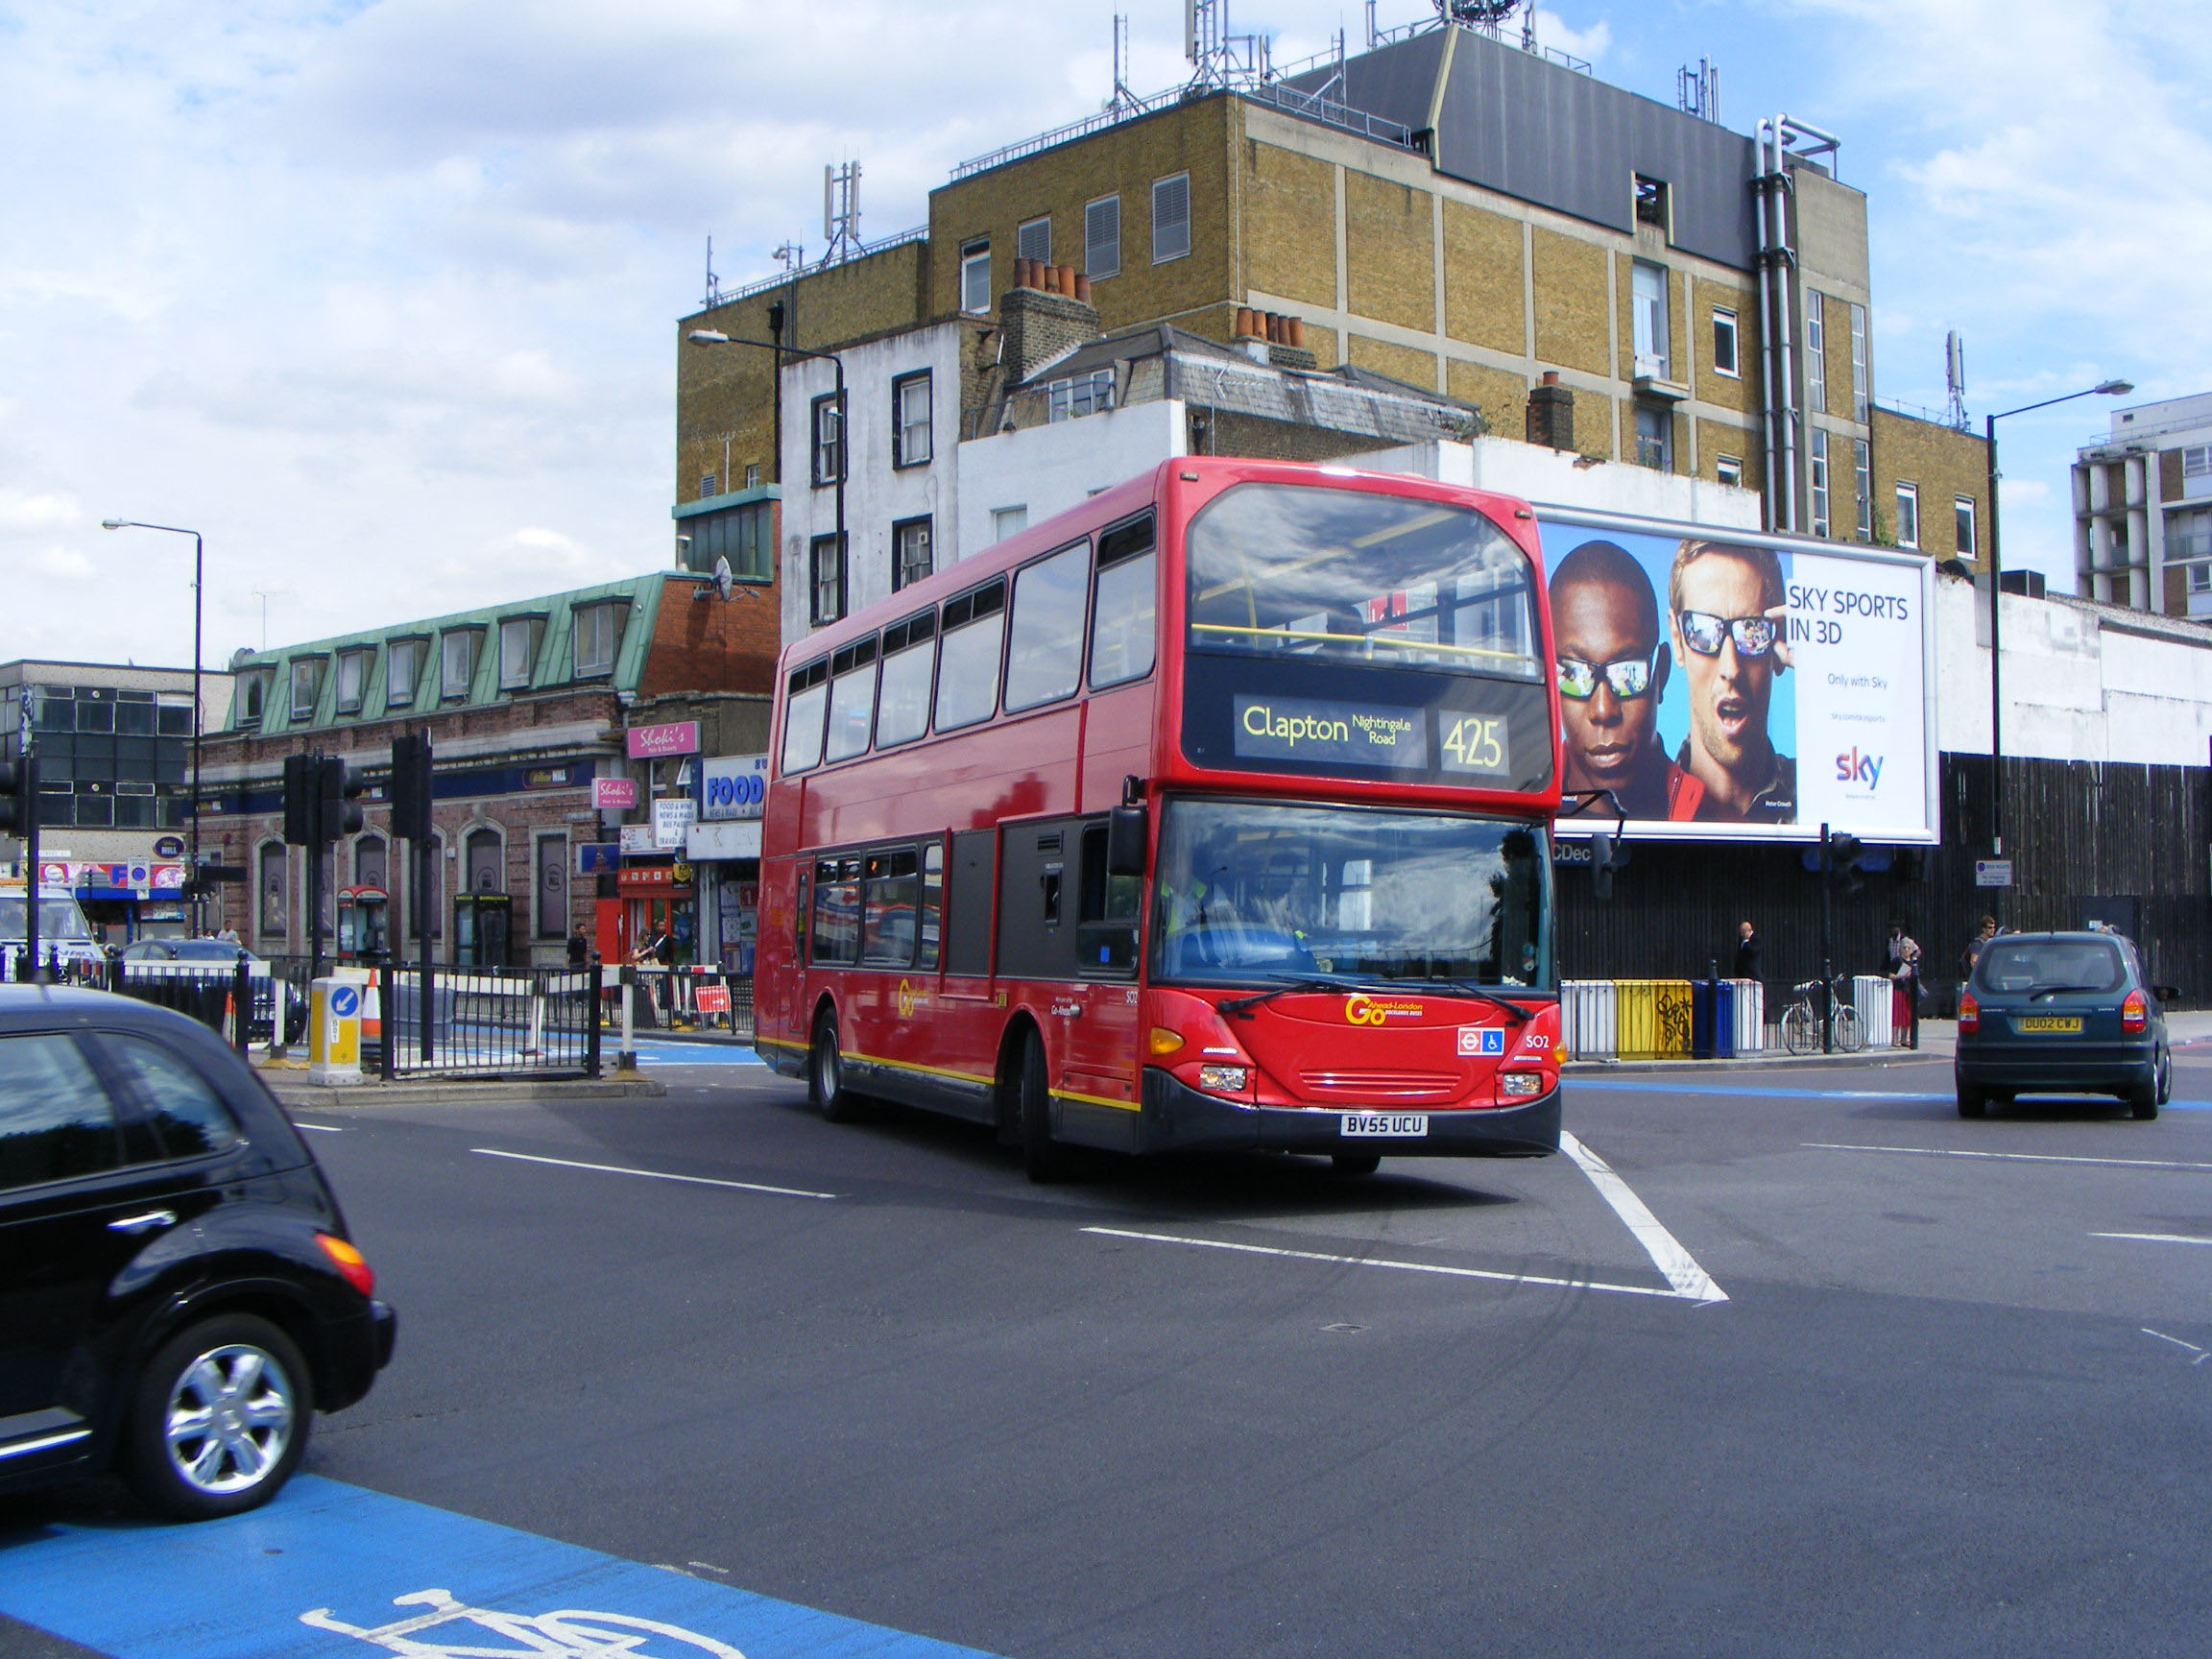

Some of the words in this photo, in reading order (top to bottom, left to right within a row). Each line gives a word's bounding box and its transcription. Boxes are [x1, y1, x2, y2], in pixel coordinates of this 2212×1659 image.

[1790, 586, 1828, 612] SKY
[1834, 590, 1908, 620] SPORTS
[1791, 617, 1810, 641] IN
[1816, 620, 1842, 644] 3D
[1828, 673, 1849, 688] Only
[1850, 676, 1870, 687] with
[1871, 677, 1888, 691] Sky
[1243, 706, 1348, 747] Clapton
[1352, 713, 1411, 733] Nightingale
[640, 725, 685, 748] Shoki's
[1369, 731, 1396, 745] Road
[1442, 717, 1503, 768] 425
[1836, 745, 1884, 790] sky
[600, 782, 634, 796] Shoki's
[708, 775, 764, 806] FOOD
[1345, 996, 1385, 1026] Go
[2056, 1018, 2080, 1029] CWJ
[1347, 1117, 1388, 1133] BV55
[1392, 1117, 1423, 1133] UCU
